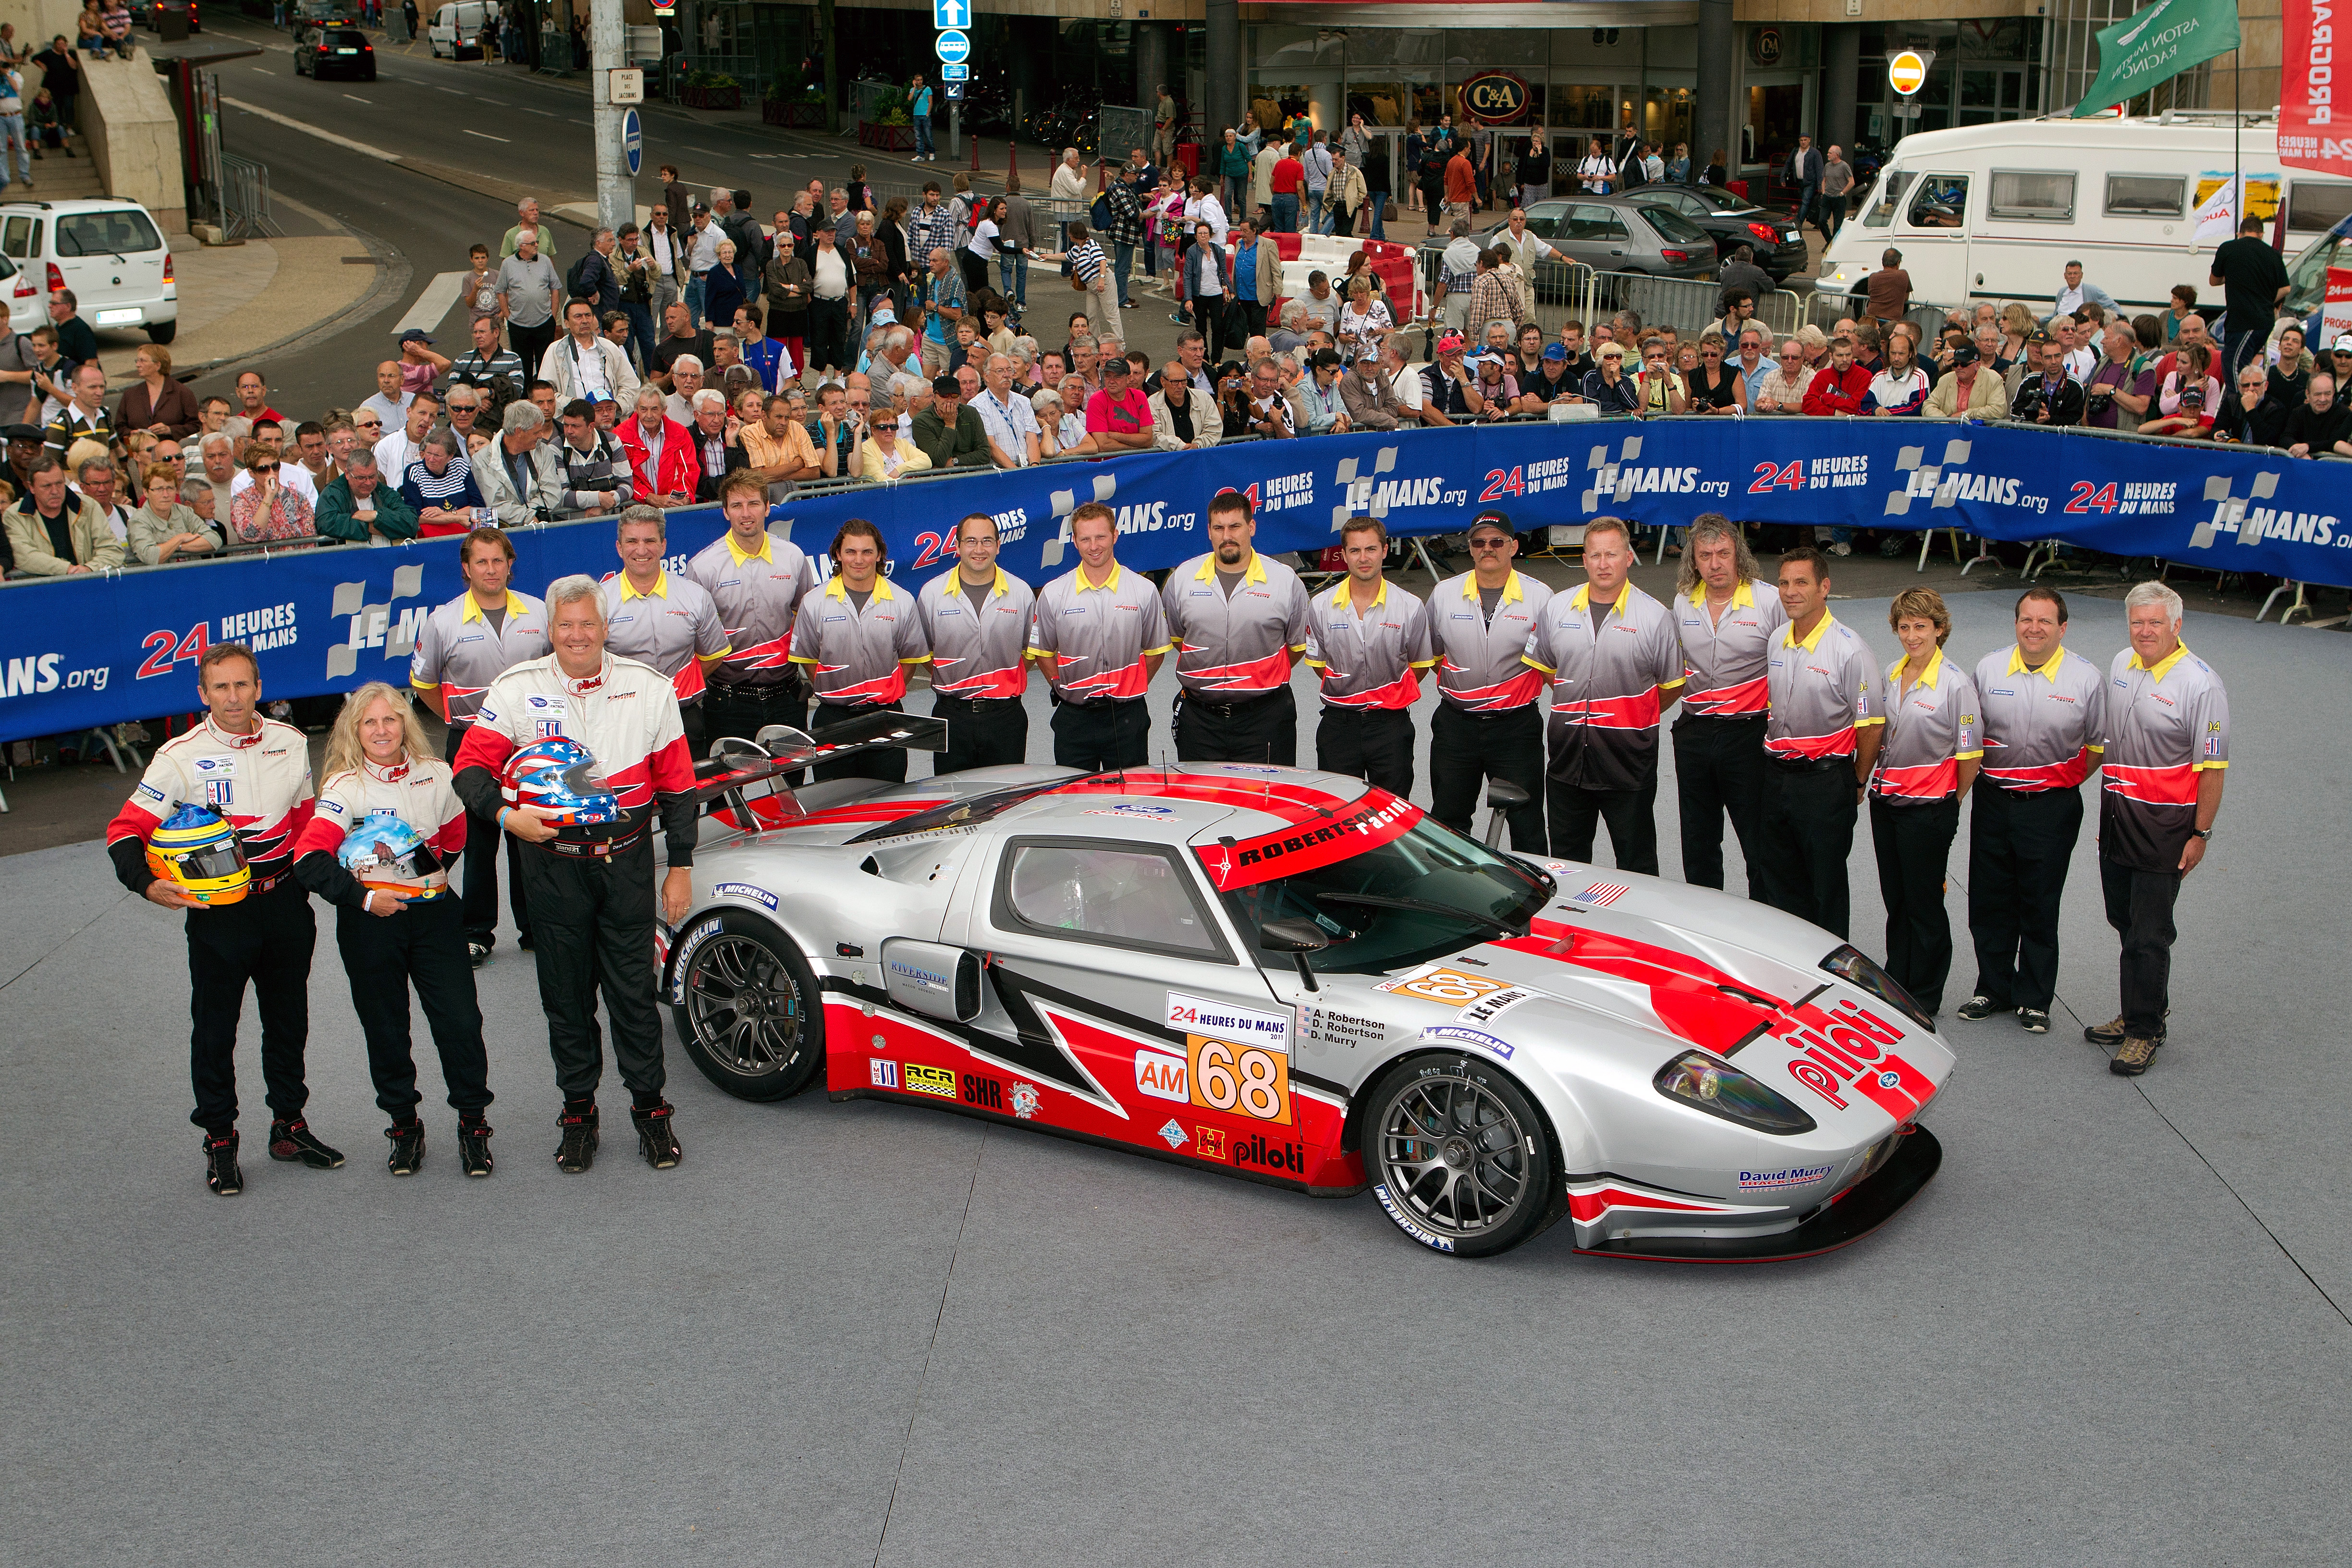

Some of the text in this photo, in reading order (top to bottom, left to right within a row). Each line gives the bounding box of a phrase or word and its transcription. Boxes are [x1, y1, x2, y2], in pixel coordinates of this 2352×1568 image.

[1473, 86, 1517, 108] C&A
[2328, 285, 2341, 295] 24
[1266, 472, 1313, 496] HEURES
[1478, 457, 1569, 503] 24 HEURES
[1528, 475, 1568, 494] DU MANS
[1593, 468, 1617, 495] LE
[1748, 455, 1868, 493] 24 HEURES
[1811, 472, 1868, 489] DU MANS
[1906, 471, 1938, 498] LE
[1265, 490, 1313, 513] DU MANS
[1346, 483, 1369, 511] LE
[2064, 480, 2177, 514] 24 HEURES
[2120, 502, 2175, 514] DU MANS
[1058, 515, 1073, 544] L
[2210, 502, 2246, 533] LE
[136, 602, 295, 680] 24 HEURES
[253, 626, 298, 654] MANS
[349, 611, 387, 651] LE
[607, 691, 637, 699] ROBERTSON
[1960, 714, 1974, 724] 04
[1080, 809, 1183, 822] RACING
[1239, 806, 1378, 866] ROBERTSON
[724, 884, 777, 906] MICHELIN
[674, 919, 719, 982] MICHELIN
[892, 960, 948, 986] RIVERSIDE
[1408, 971, 1499, 1001] 68
[1381, 982, 1393, 992] 24
[1169, 1005, 1285, 1034] 24 HEURES DU MANS
[1313, 1009, 1384, 1030] A. Robertson
[1470, 1005, 1495, 1022] LE
[1492, 991, 1526, 1009] MANS
[1311, 1030, 1357, 1048] D. Murry
[1312, 1018, 1384, 1041] D. Robertson
[1437, 1028, 1511, 1054] MICHELIN
[1788, 999, 1905, 1111] piloti
[906, 1066, 955, 1084] RCR
[931, 1080, 954, 1089] REPLICAS
[1139, 1061, 1185, 1094] AM
[1196, 1041, 1281, 1119] 68
[963, 1074, 1003, 1110] SHR
[1200, 1134, 1222, 1150] Craft
[1233, 1135, 1305, 1174] piloti
[1739, 1164, 1834, 1181] David Murry
[1785, 1174, 1824, 1185] DAYS
[1375, 1187, 1437, 1246] MICHELIN
